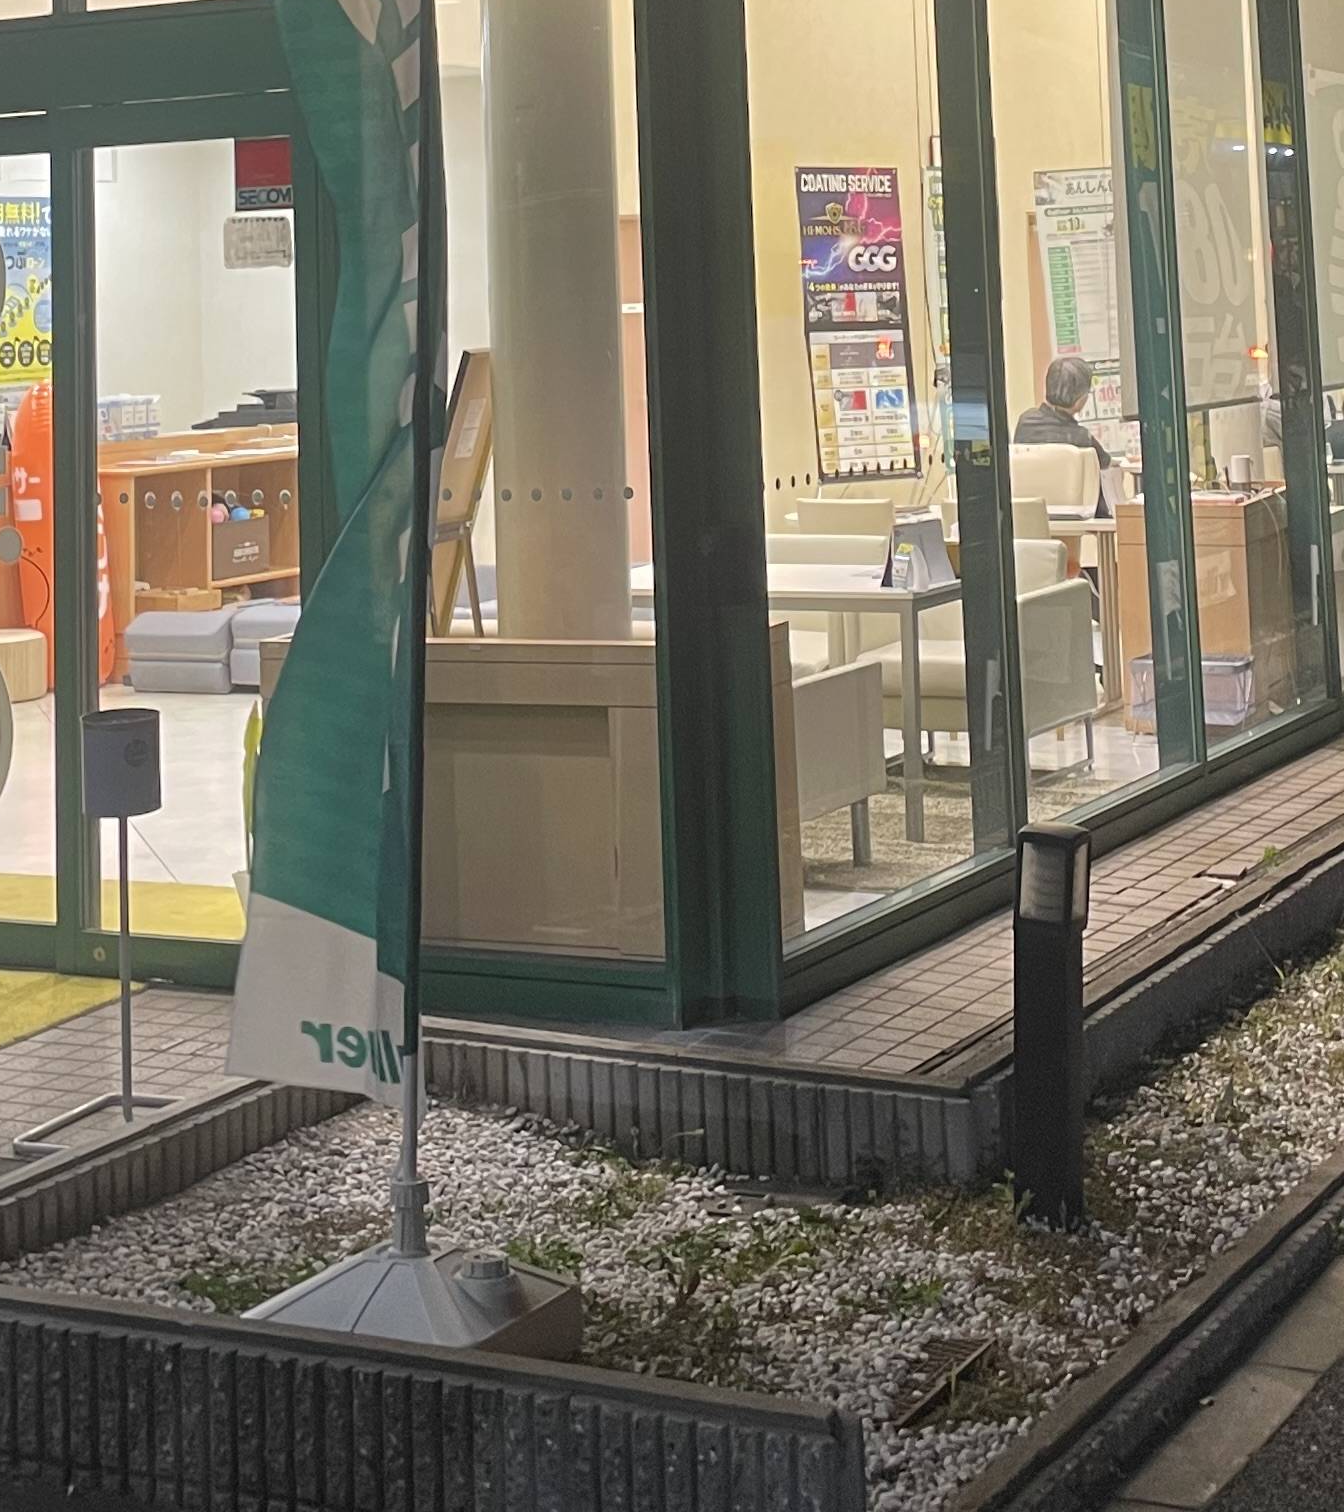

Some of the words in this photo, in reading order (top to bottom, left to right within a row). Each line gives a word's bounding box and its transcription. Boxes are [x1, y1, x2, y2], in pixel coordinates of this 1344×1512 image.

[800, 174, 847, 192] COATING
[848, 174, 892, 193] SERVICE
[239, 187, 292, 206] SECOM
[848, 245, 897, 272] GGG
